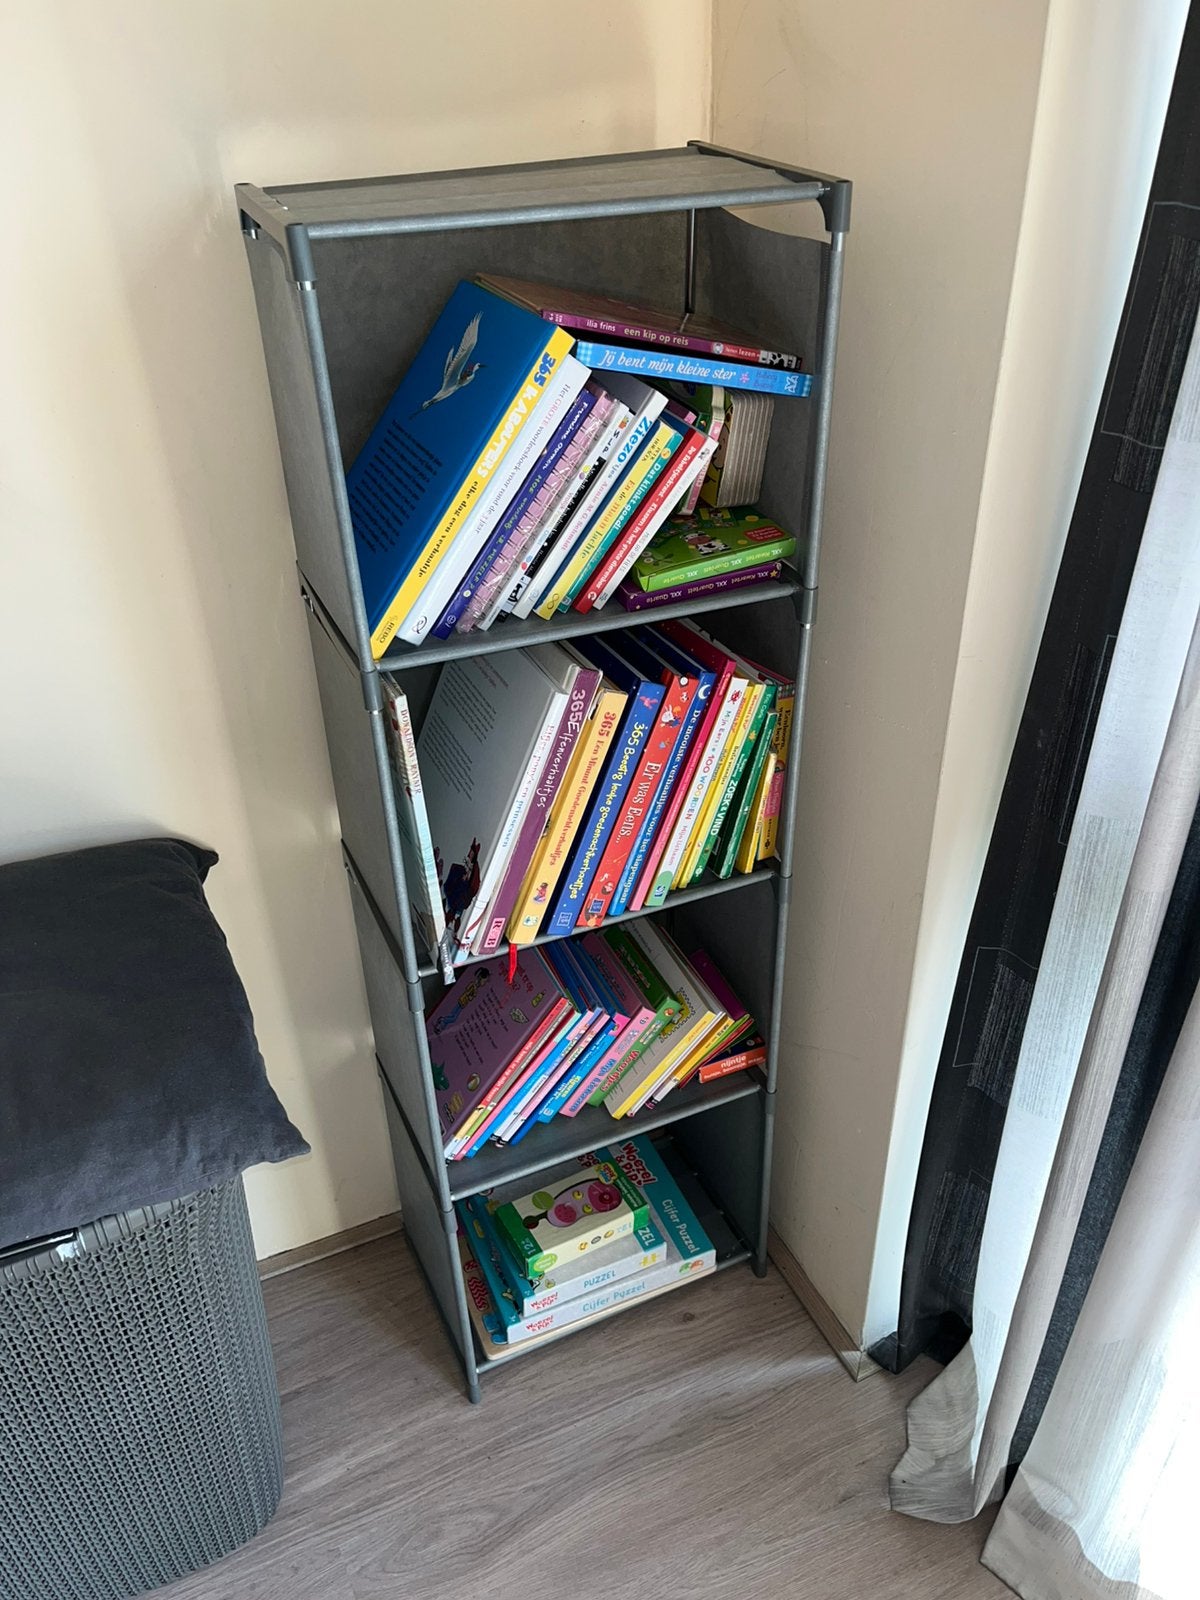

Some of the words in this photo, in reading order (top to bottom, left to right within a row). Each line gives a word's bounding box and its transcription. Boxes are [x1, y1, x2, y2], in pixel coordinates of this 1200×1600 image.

[586, 319, 597, 328] ilia
[599, 321, 616, 331] frins
[623, 327, 640, 336] een
[642, 330, 656, 341] kip
[658, 335, 670, 343] op
[673, 335, 689, 345] reis
[529, 352, 558, 387] 365
[617, 351, 646, 369] bent
[647, 356, 674, 375] mijn
[675, 359, 711, 378] kleine
[712, 367, 736, 381] ster
[558, 384, 570, 398] Het
[513, 425, 545, 471] voorleesboek
[687, 445, 696, 456] De
[647, 461, 662, 479] Dat
[463, 480, 479, 500] elke
[591, 480, 608, 504] Annie
[617, 491, 627, 502] de
[623, 478, 636, 492] En
[629, 478, 651, 506] klinkt
[452, 499, 467, 517] dag
[598, 501, 620, 530] maan
[611, 503, 633, 531] goed!
[443, 517, 456, 533] een
[560, 520, 583, 551] Schmidt
[578, 529, 603, 560] lachte
[626, 533, 636, 545] het
[770, 547, 783, 555] XXL
[416, 533, 447, 578] verhaaltje
[731, 557, 743, 565] XXL
[686, 569, 699, 577] XXL
[715, 579, 728, 587] XXL
[669, 590, 682, 598] XXL
[378, 621, 394, 643] REBO
[596, 710, 617, 738] 365
[689, 708, 701, 724] De
[627, 720, 646, 747] 365
[674, 724, 694, 763] mooiste
[400, 708, 415, 758] DONALDSON
[409, 763, 421, 794] RAYNER
[611, 744, 635, 782] Beestig
[642, 758, 662, 781] Er
[702, 753, 715, 774] 100
[603, 780, 622, 806] leuke
[631, 778, 651, 806] was
[652, 763, 679, 815] verhaaltjes
[684, 774, 707, 821] WOORDEN
[721, 779, 738, 807] ZOEK
[499, 799, 524, 848] prinsessen
[615, 803, 643, 847] Eens...
[645, 815, 658, 837] voor
[709, 810, 725, 837] VIND
[565, 803, 612, 900] goedenachtverhaaltjes
[639, 838, 650, 853] het
[617, 852, 644, 905] slapengaan
[720, 1054, 747, 1068] nijntje
[621, 1162, 640, 1183] Pip
[622, 1141, 657, 1184] Woezel
[662, 1199, 679, 1227] Cijfer
[676, 1223, 700, 1253] Puzzel
[583, 1270, 616, 1288] PUZZEL
[531, 1292, 558, 1308] Woezel
[582, 1297, 610, 1313] Cijfer
[613, 1282, 645, 1301] Puzzel
[526, 1315, 554, 1330] Woezel
